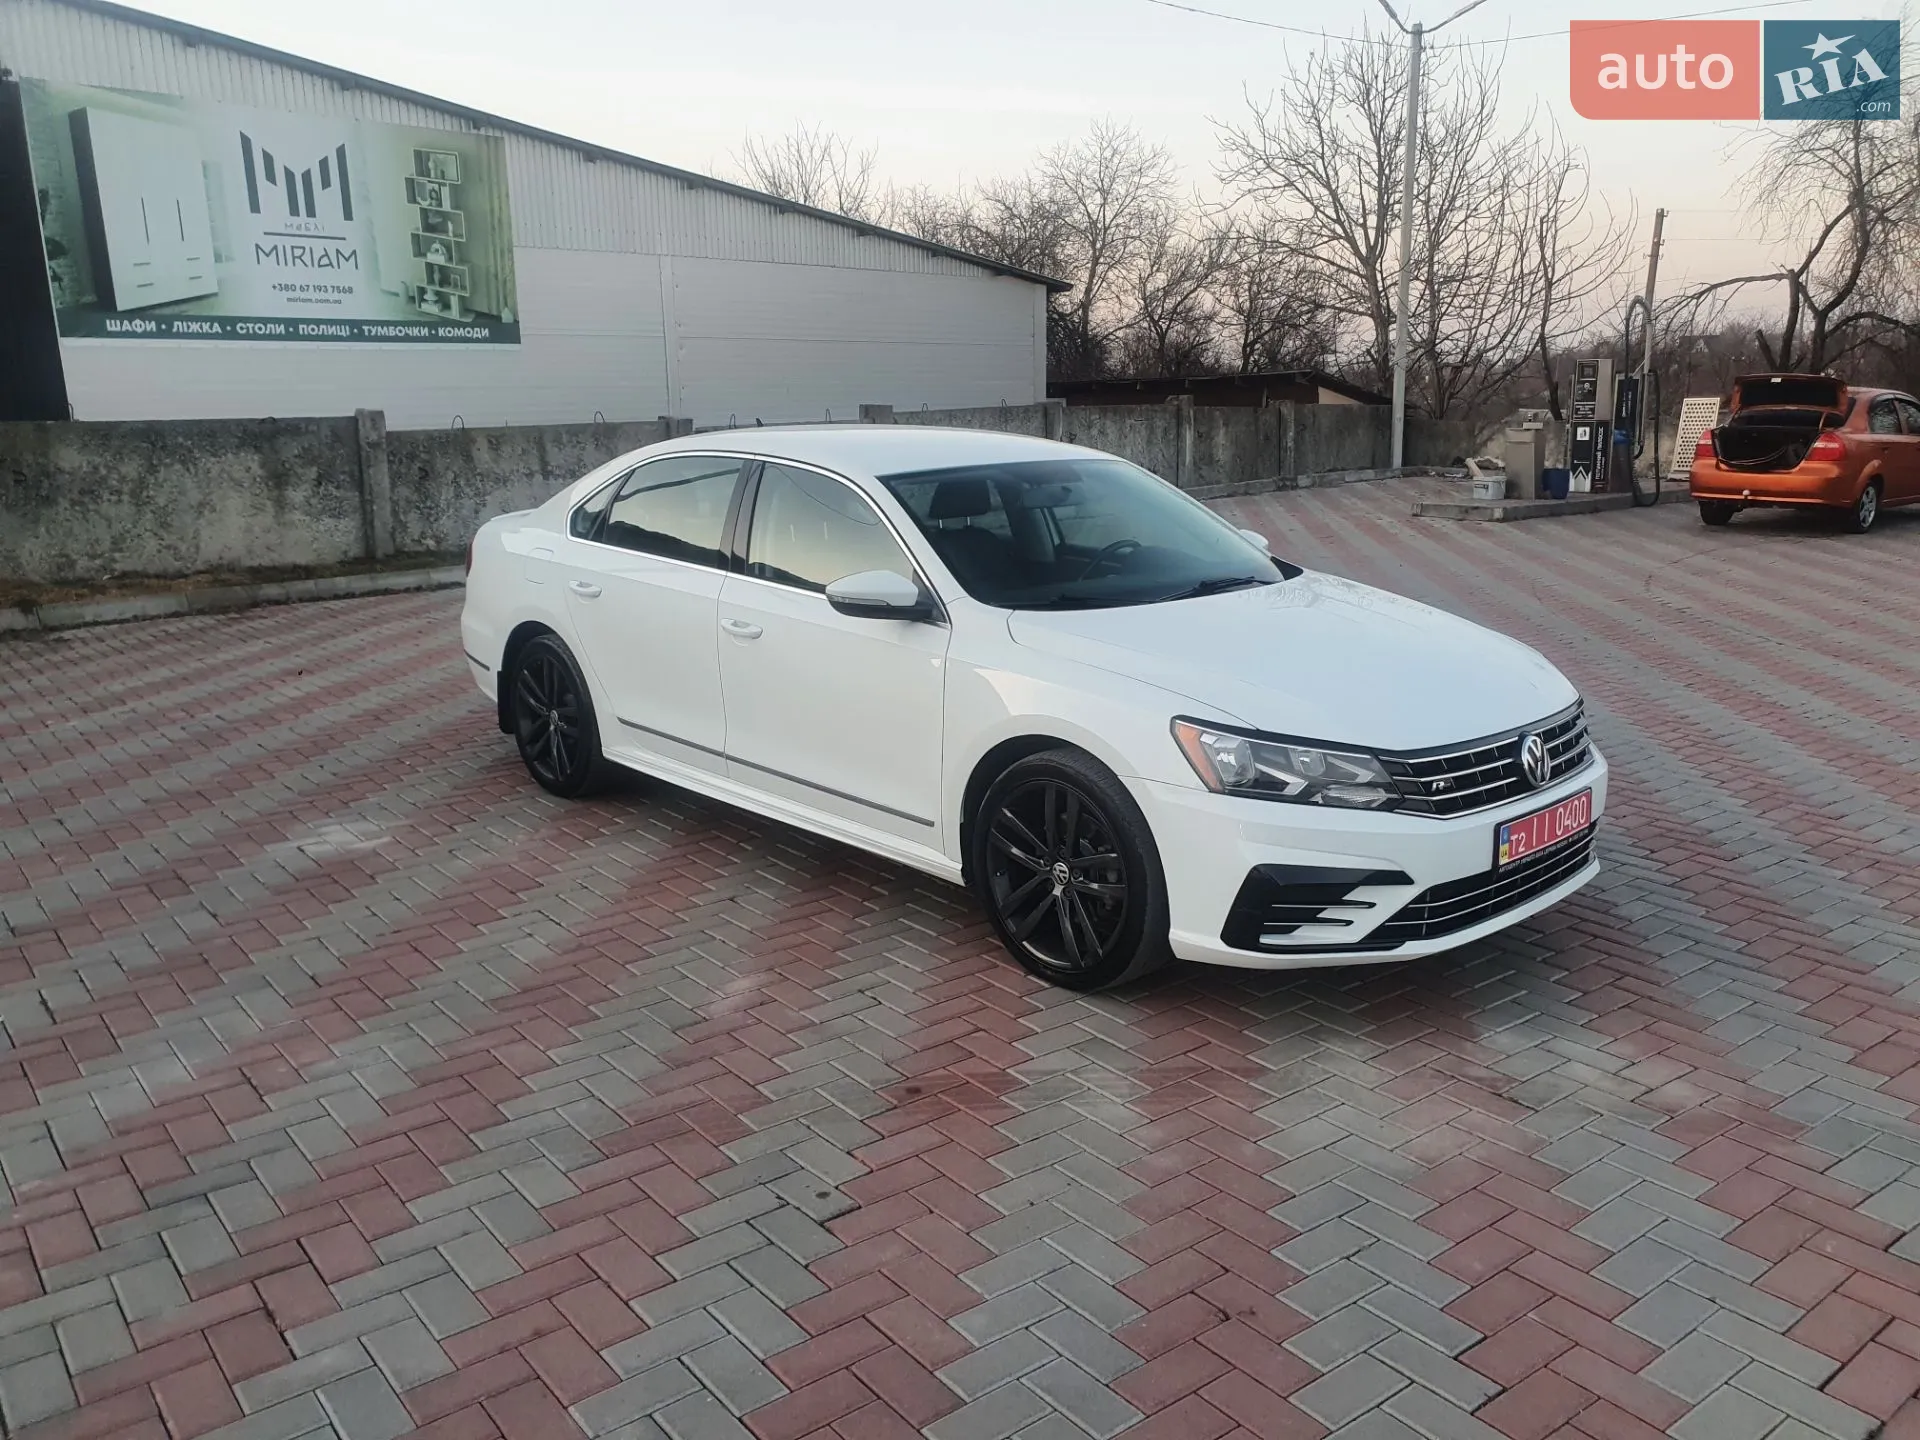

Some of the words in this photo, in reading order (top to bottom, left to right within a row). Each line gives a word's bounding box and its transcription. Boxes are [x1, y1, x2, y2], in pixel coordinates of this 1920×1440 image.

[255, 243, 358, 270] MIRIAM
[272, 283, 296, 293] +380
[299, 284, 311, 293] 67
[312, 284, 329, 294] 193
[330, 285, 354, 295] 7568
[286, 296, 342, 305] miriam.com.ua
[106, 319, 156, 333] ШАФИ
[172, 321, 222, 334] ЛІЖКА
[236, 322, 286, 335] СТОЛИ
[299, 324, 350, 337] ПОЛИЦІ
[362, 325, 429, 337] ТУМБОЧКИ
[438, 327, 489, 339] КОМОДИ
[1556, 796, 1587, 836] 0400
